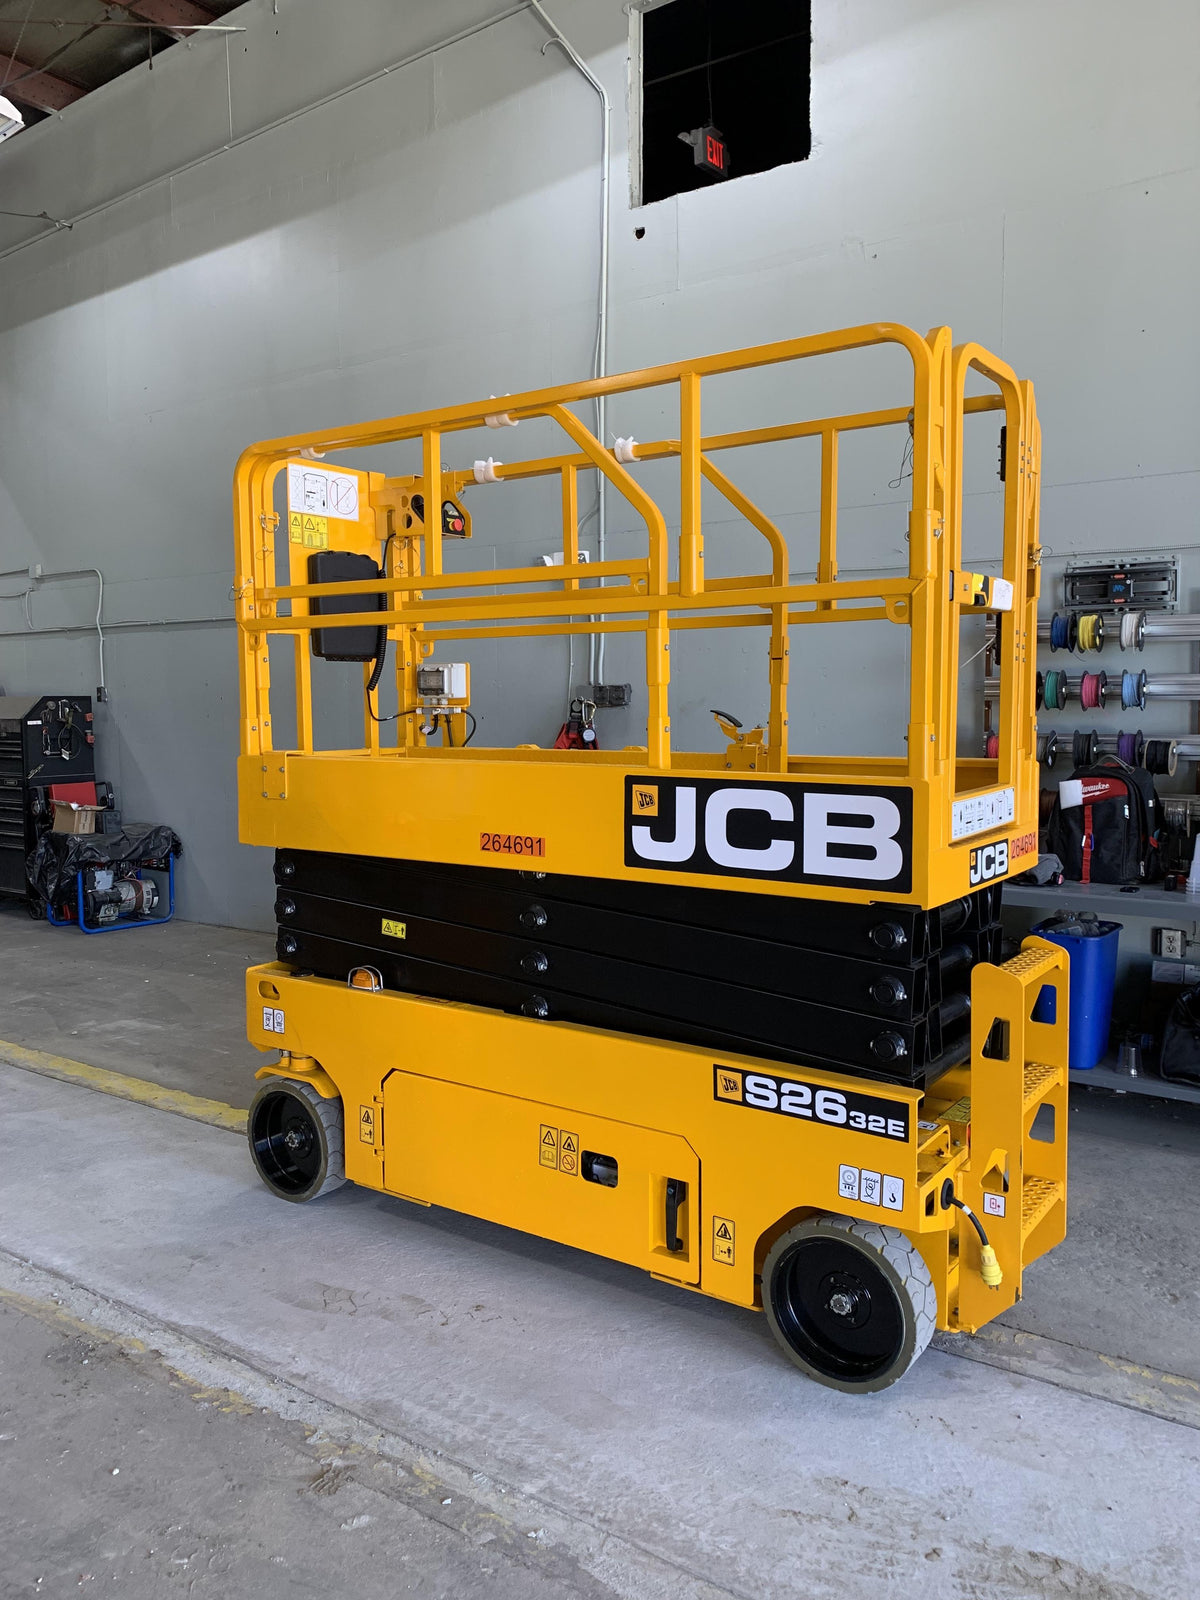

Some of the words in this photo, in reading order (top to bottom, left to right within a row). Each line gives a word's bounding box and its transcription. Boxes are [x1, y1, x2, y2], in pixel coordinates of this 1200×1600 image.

[706, 135, 724, 169] EXIT
[638, 792, 655, 807] JCB
[1081, 781, 1110, 793] lwaukee
[481, 832, 542, 856] 264691
[632, 786, 903, 881] JCB
[1011, 832, 1037, 859] 264691
[970, 842, 1008, 884] JCB
[723, 1077, 738, 1091] JCB
